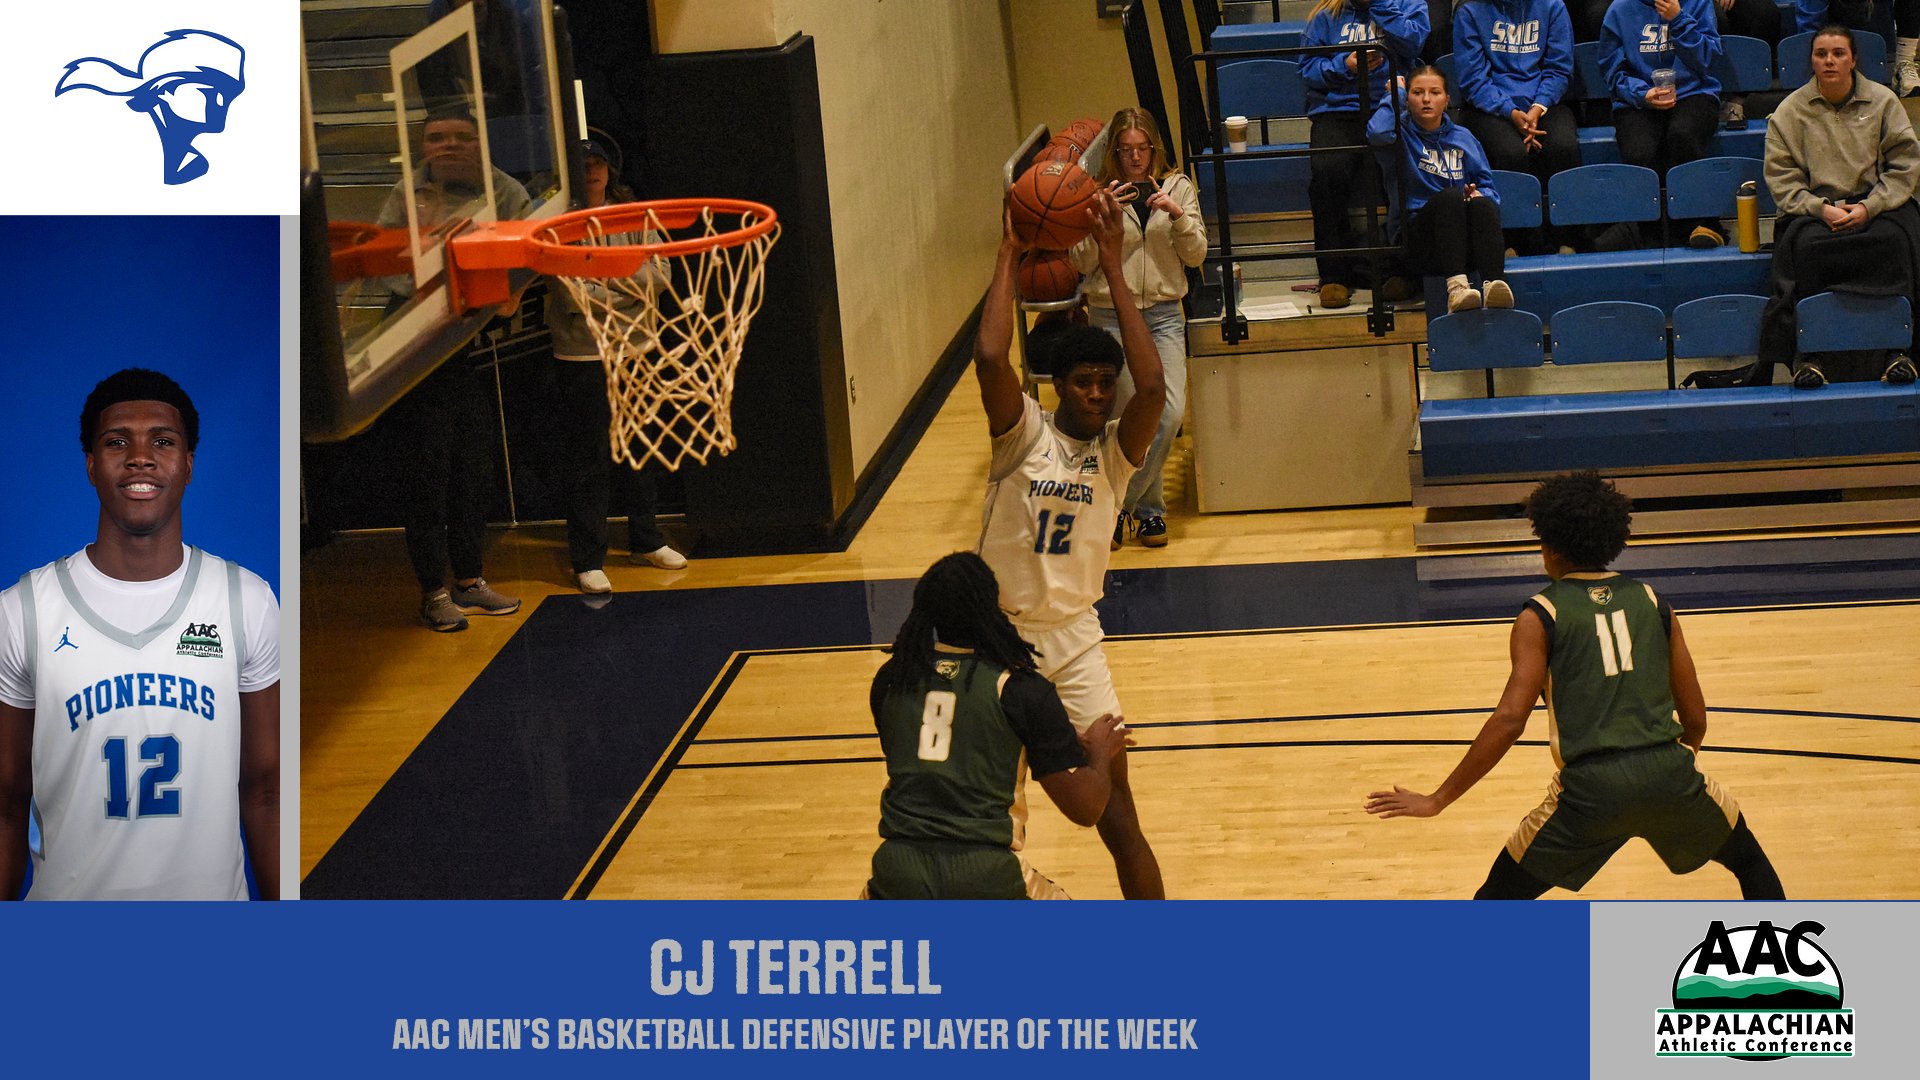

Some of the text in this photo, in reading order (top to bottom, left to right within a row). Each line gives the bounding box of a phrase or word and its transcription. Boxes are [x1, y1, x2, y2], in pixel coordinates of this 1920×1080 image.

[1490, 19, 1539, 45] SMC
[1034, 508, 1076, 556] 12
[176, 644, 223, 653] APPALACHIAN
[186, 622, 217, 639] AAC
[1594, 609, 1633, 676] 11
[65, 671, 216, 732] PIONEERS
[917, 691, 956, 761] 8
[101, 733, 183, 821] 12
